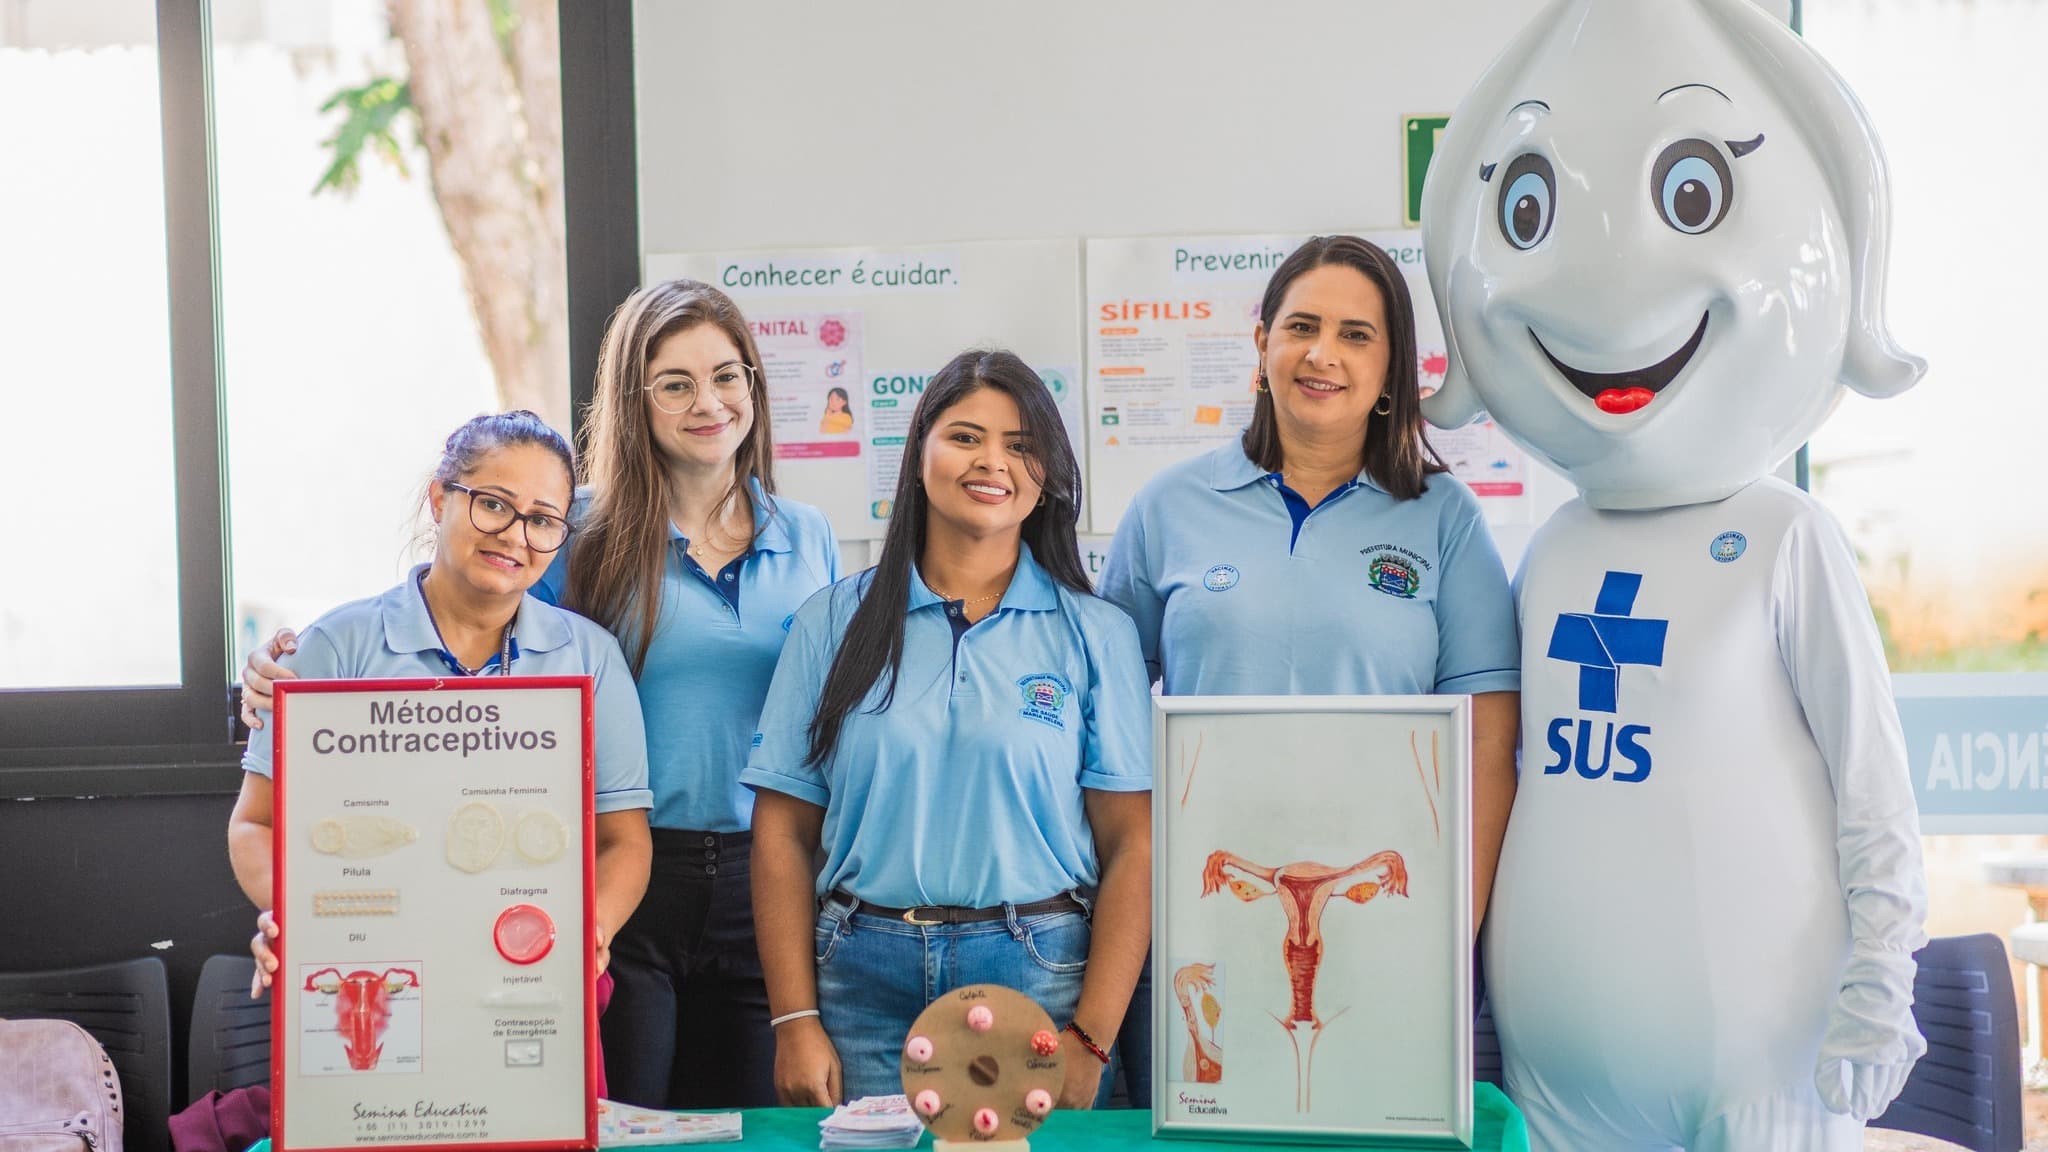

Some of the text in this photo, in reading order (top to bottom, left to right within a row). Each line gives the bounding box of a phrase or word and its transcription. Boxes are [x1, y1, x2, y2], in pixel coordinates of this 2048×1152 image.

[1175, 246, 1284, 272] Prevenir
[722, 260, 958, 287] Conhecer é cuidar.
[1100, 300, 1212, 321] SÍFILIS
[872, 376, 934, 394] GON
[1359, 543, 1433, 572] PREFEITURA MUNICIPAL
[370, 699, 501, 725] Métodos
[1023, 711, 1043, 719] MARIA
[312, 725, 558, 758] Contraceptivos
[1543, 717, 1653, 784] SUS
[509, 786, 548, 795] Feminina
[343, 799, 390, 808] Camisinha
[500, 887, 548, 897] Diafragma
[348, 933, 367, 942] DIU
[1179, 1091, 1217, 1105] Semina
[353, 1100, 489, 1121] Semina Educativa
[1188, 1104, 1228, 1115] Educativa
